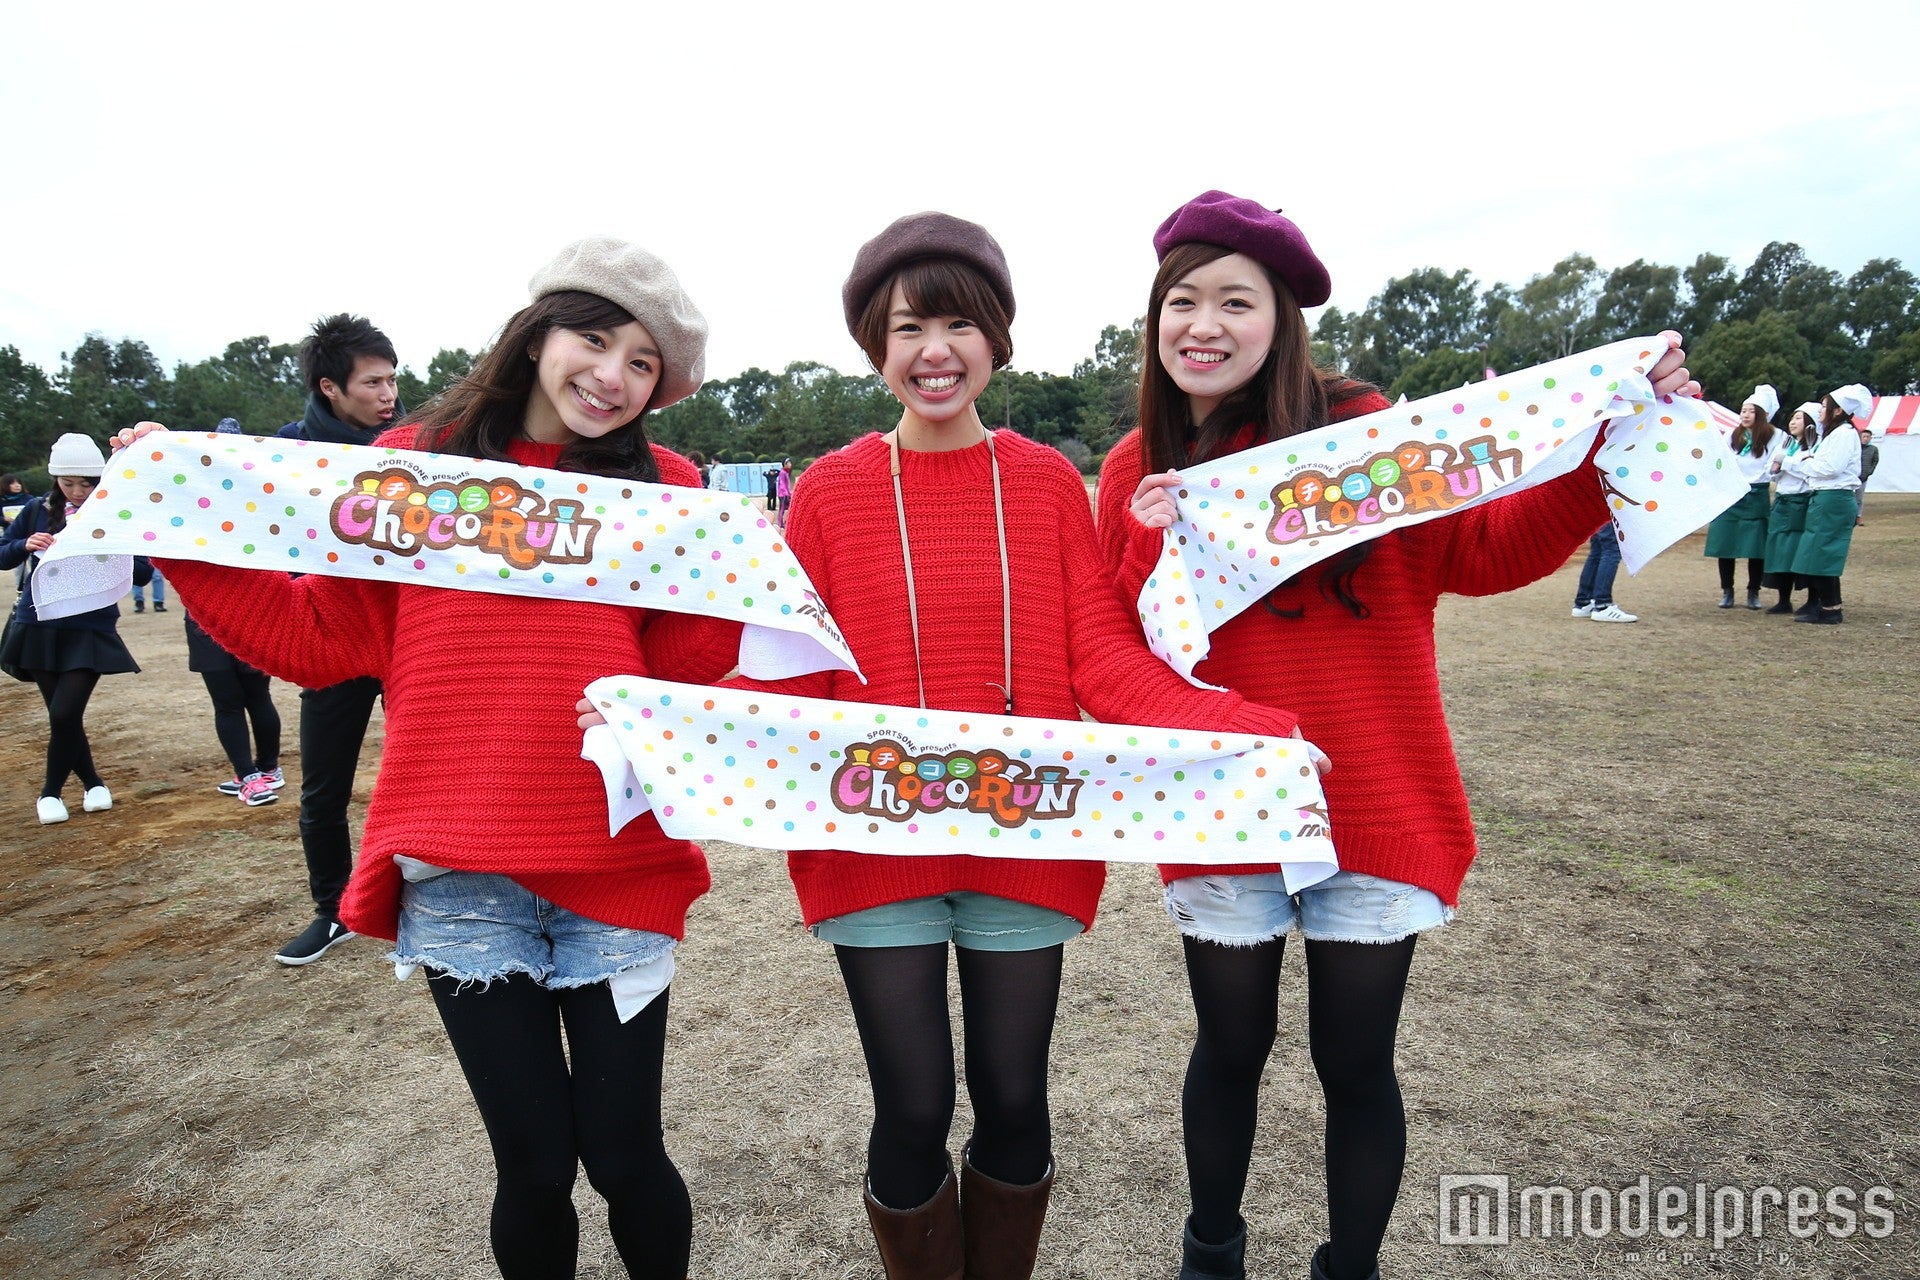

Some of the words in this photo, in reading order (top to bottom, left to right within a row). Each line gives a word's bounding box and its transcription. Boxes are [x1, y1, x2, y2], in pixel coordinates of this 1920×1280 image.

[376, 459, 429, 482] SPORTSONE
[432, 471, 470, 482] presents
[1284, 463, 1335, 478] SPORTSONE
[1337, 450, 1373, 469] presents
[866, 729, 917, 753] SPORTSONE
[920, 742, 957, 753] presents
[877, 752, 1000, 777] チョコラン
